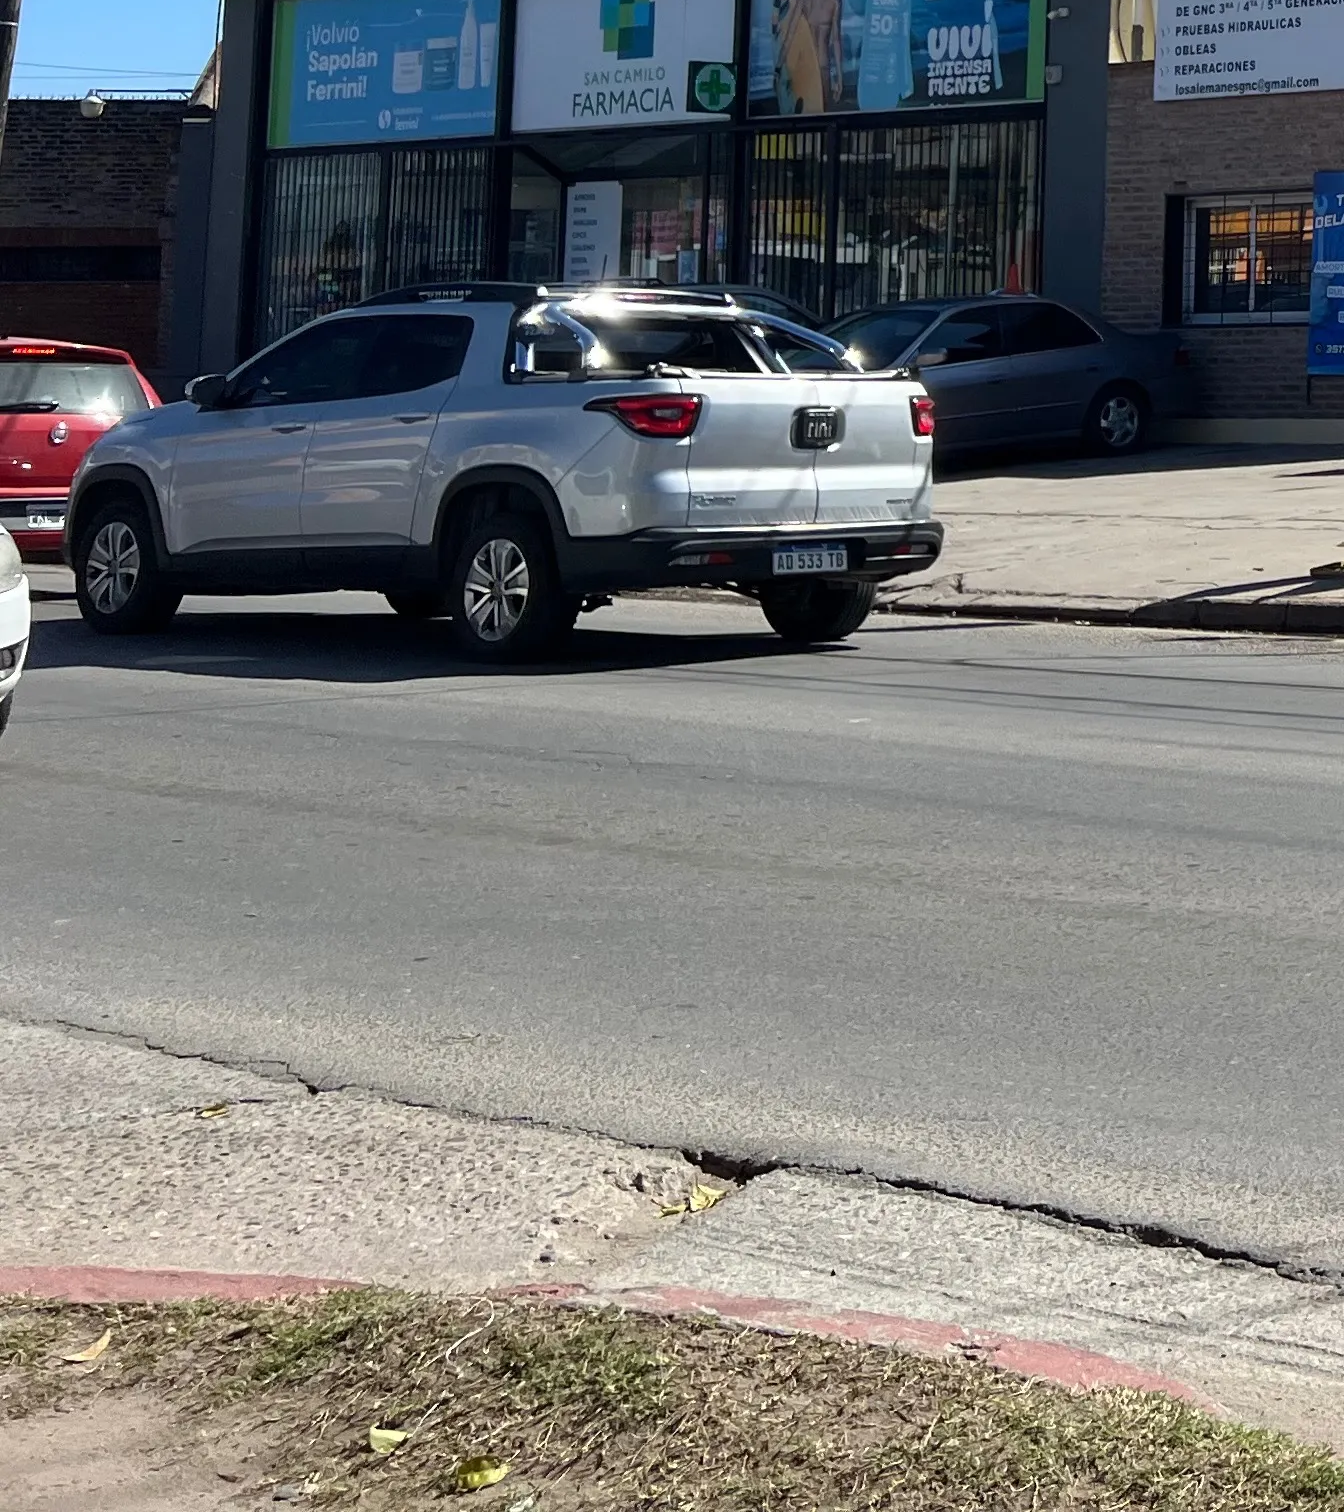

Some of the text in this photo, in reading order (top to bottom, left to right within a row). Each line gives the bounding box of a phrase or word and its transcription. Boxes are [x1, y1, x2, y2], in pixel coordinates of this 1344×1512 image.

[1176, 5, 1190, 17] DE
[1193, 3, 1217, 16] GNC
[306, 20, 359, 51] ¡Volvió
[1175, 17, 1302, 37] PRUEBAS HIDRAULICAS
[1175, 43, 1216, 56] OBLEAS
[309, 46, 378, 76] Sapolán
[928, 59, 991, 77] INTENSA
[1174, 60, 1256, 76] REPARACIONES
[584, 66, 666, 86] SAN CAMILO
[928, 75, 990, 97] MENTE
[1175, 76, 1319, 96] losalemanesgnc@gmail.com
[307, 76, 367, 102] Ferrini!
[572, 88, 674, 118] FARMACIA
[777, 550, 844, 570] AD 533 TB
